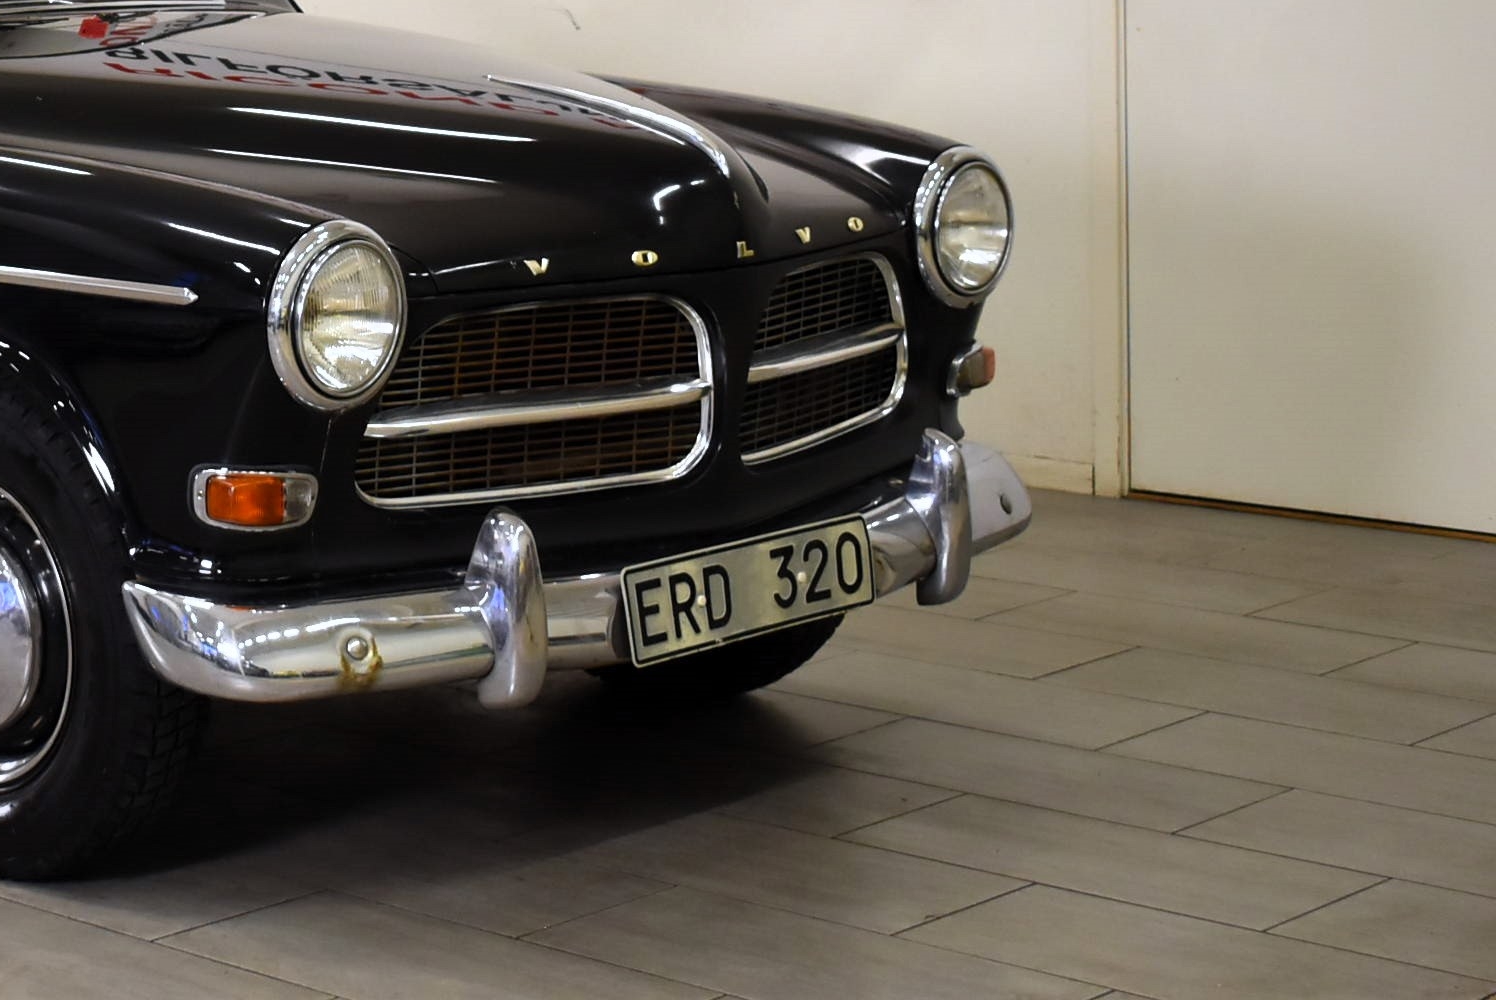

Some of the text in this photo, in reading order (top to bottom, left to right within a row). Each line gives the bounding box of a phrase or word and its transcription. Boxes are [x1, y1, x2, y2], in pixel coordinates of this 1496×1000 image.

[523, 216, 864, 277] VOLVO
[634, 531, 863, 647] ERD 320
